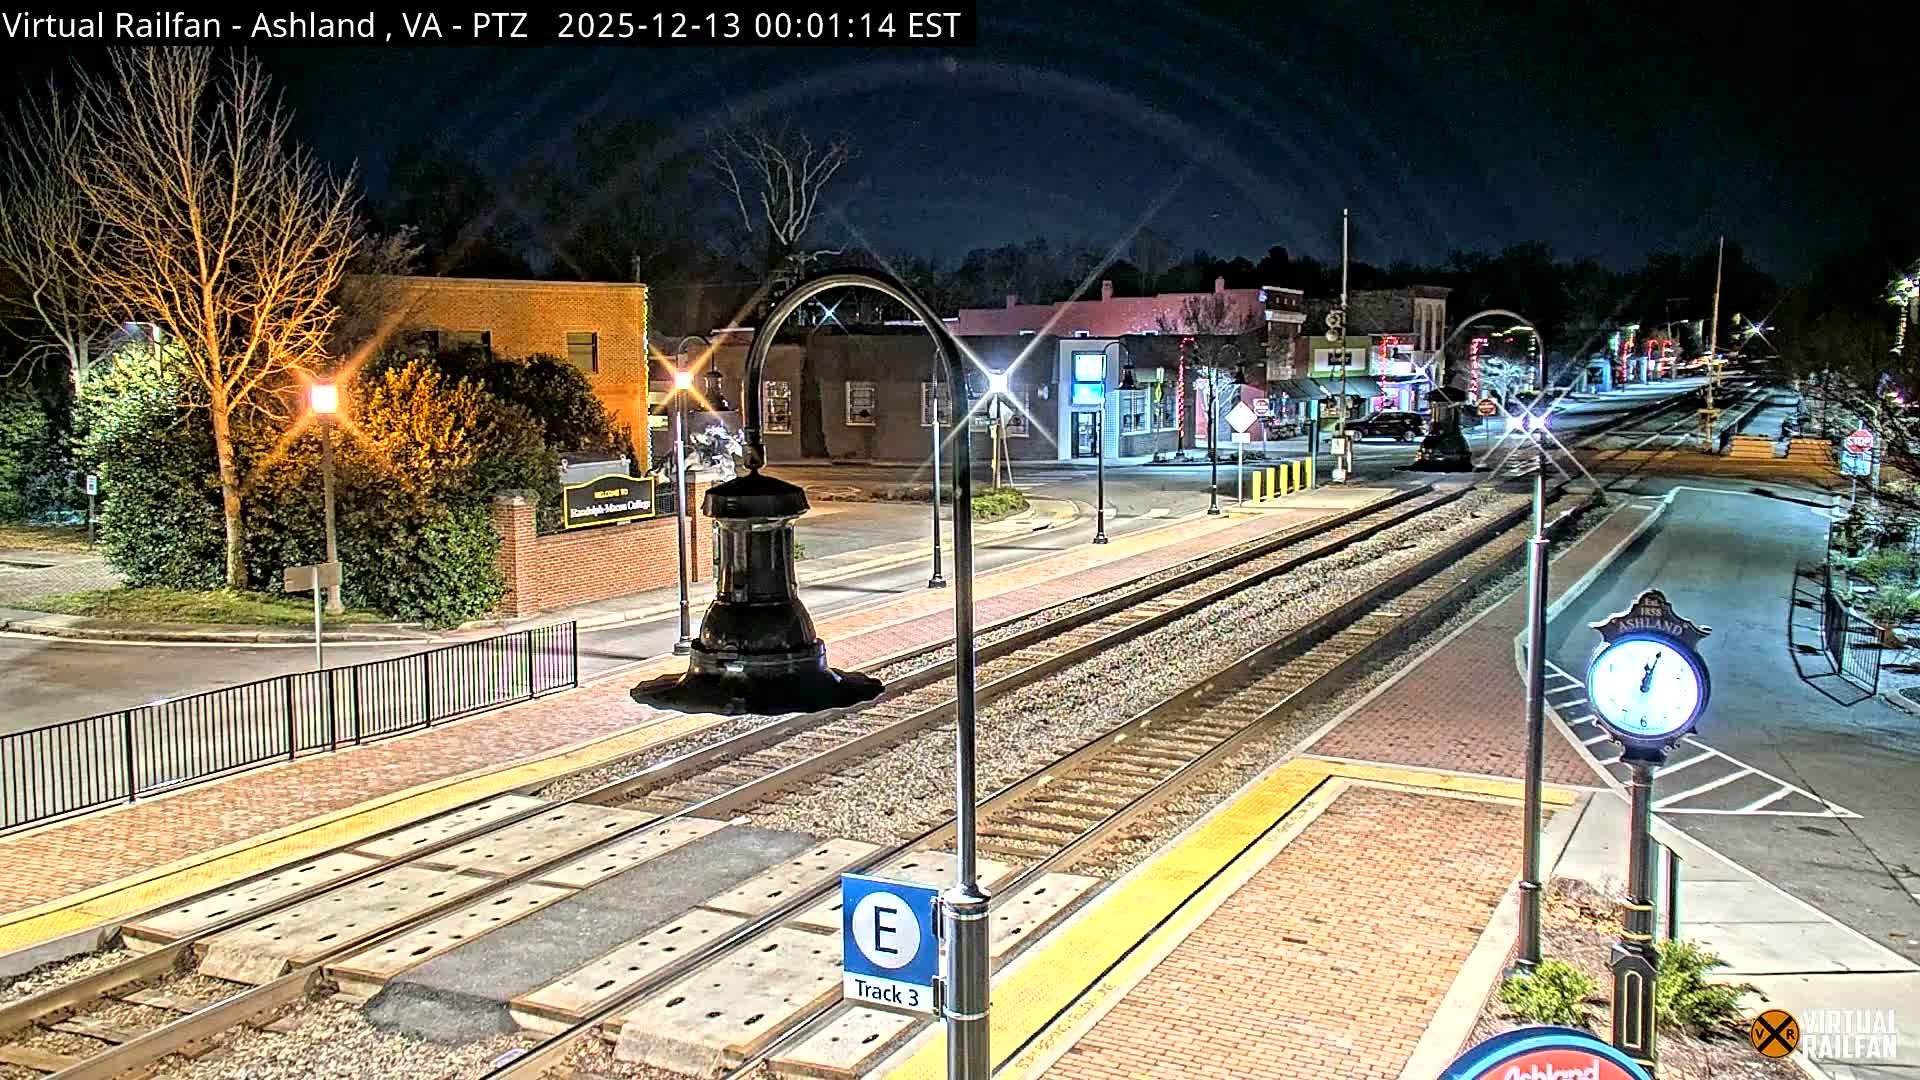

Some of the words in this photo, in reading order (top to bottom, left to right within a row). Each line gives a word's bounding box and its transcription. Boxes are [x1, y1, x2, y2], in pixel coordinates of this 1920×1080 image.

[1847, 436, 1873, 446] STOP
[1618, 617, 1682, 636] ASHLAND
[1640, 715, 1648, 728] 6
[874, 906, 898, 954] E
[855, 978, 902, 1004] Track
[908, 989, 919, 1007] 3
